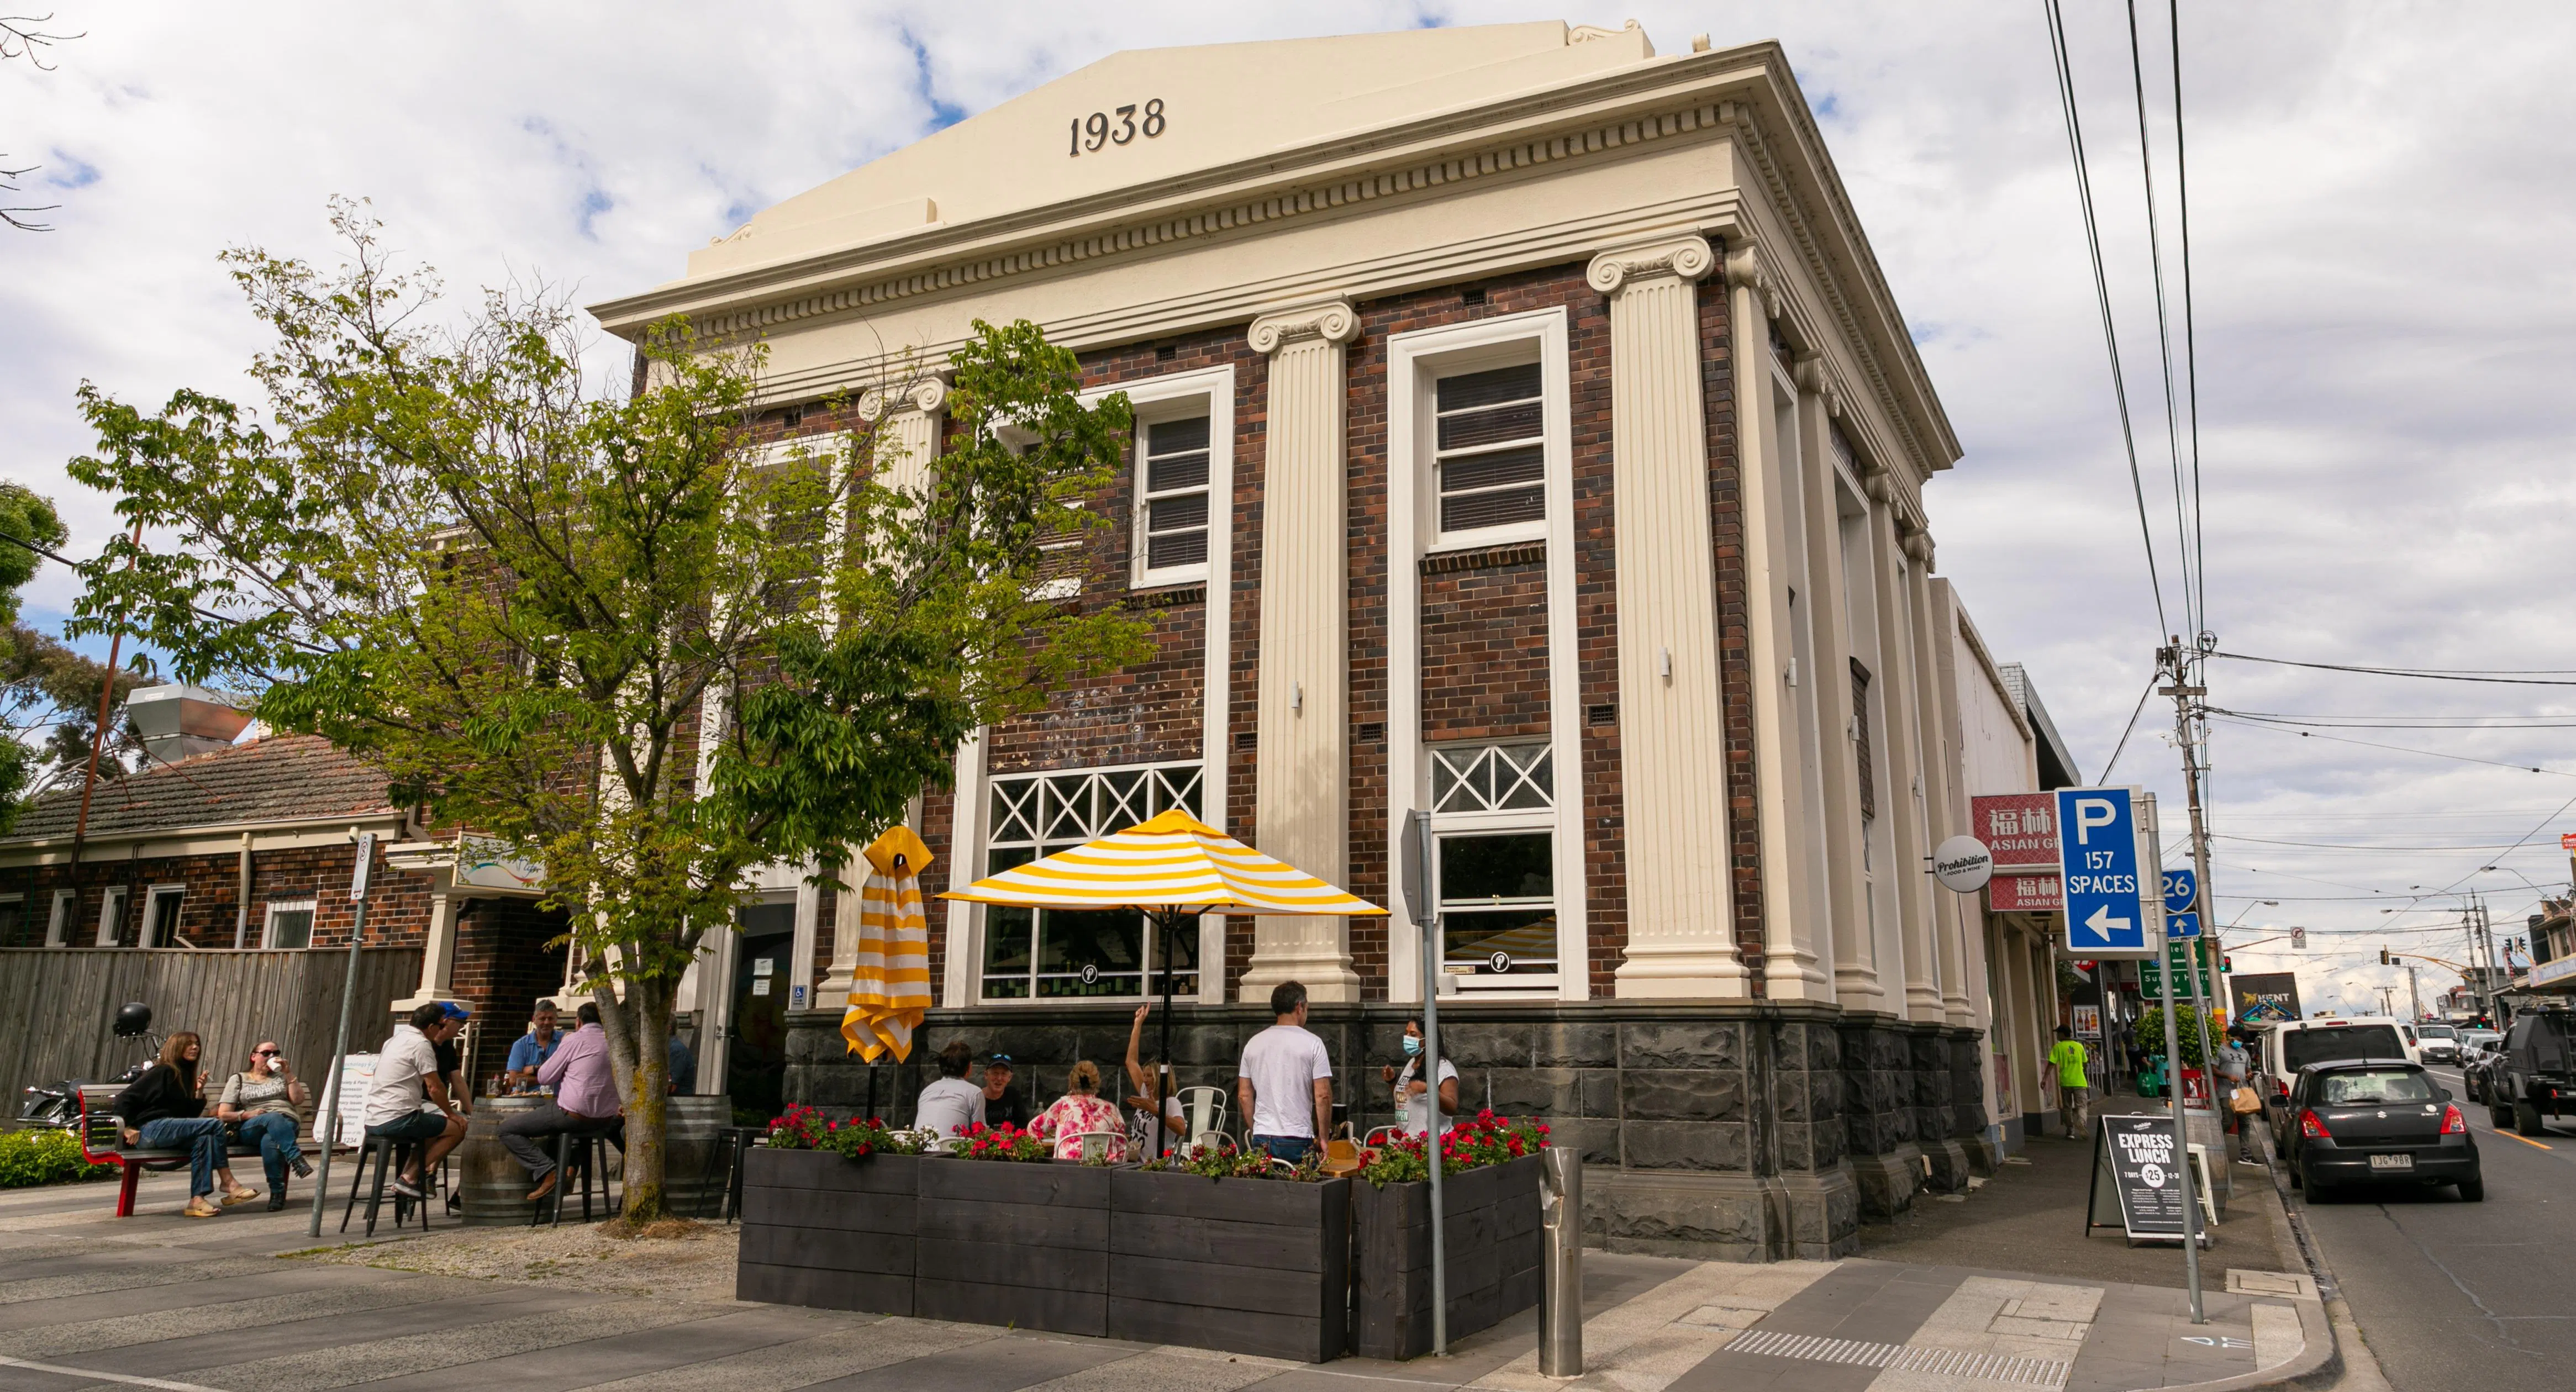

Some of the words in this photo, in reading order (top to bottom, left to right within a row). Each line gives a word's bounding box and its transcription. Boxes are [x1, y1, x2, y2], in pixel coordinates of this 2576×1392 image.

[1070, 98, 1166, 157] 1938
[1989, 808, 2051, 836] 福林
[2075, 799, 2116, 845] P
[1990, 839, 2038, 851] ASIAN
[1937, 855, 1988, 873] Prohibition
[2085, 851, 2114, 869] 157
[1947, 868, 1962, 877] FOOD
[2069, 875, 2135, 894] SPACES
[2162, 876, 2190, 897] 26
[2017, 898, 2050, 906] ASIAN
[2117, 1133, 2174, 1149] EXPRESS
[2127, 1148, 2171, 1164] LUNCH
[2145, 1169, 2160, 1180] $25
